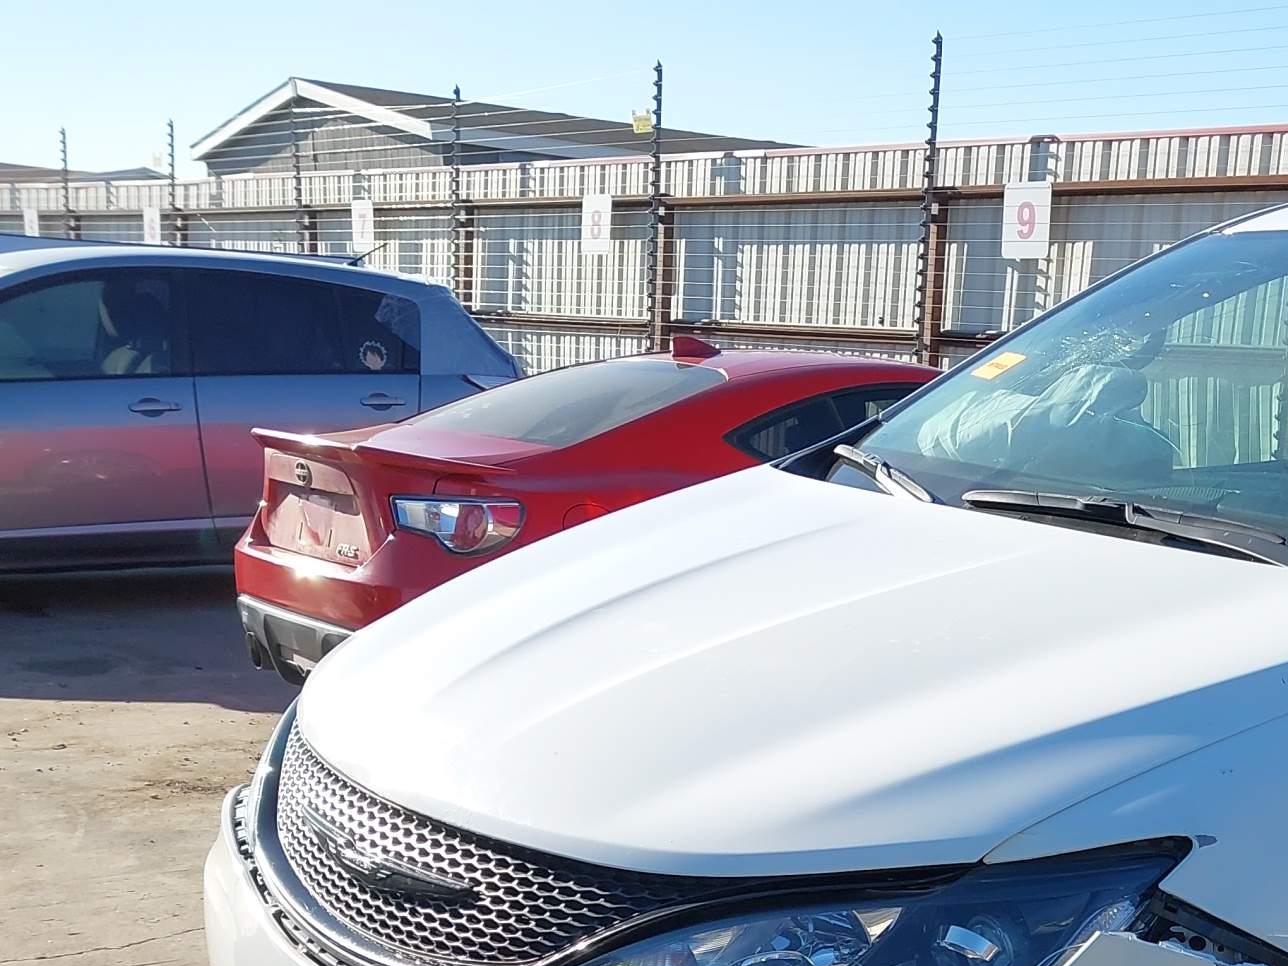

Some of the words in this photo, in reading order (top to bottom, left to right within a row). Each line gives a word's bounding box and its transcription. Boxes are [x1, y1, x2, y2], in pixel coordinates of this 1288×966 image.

[358, 213, 367, 239] 7
[590, 209, 602, 240] 8
[1016, 200, 1036, 240] 9
